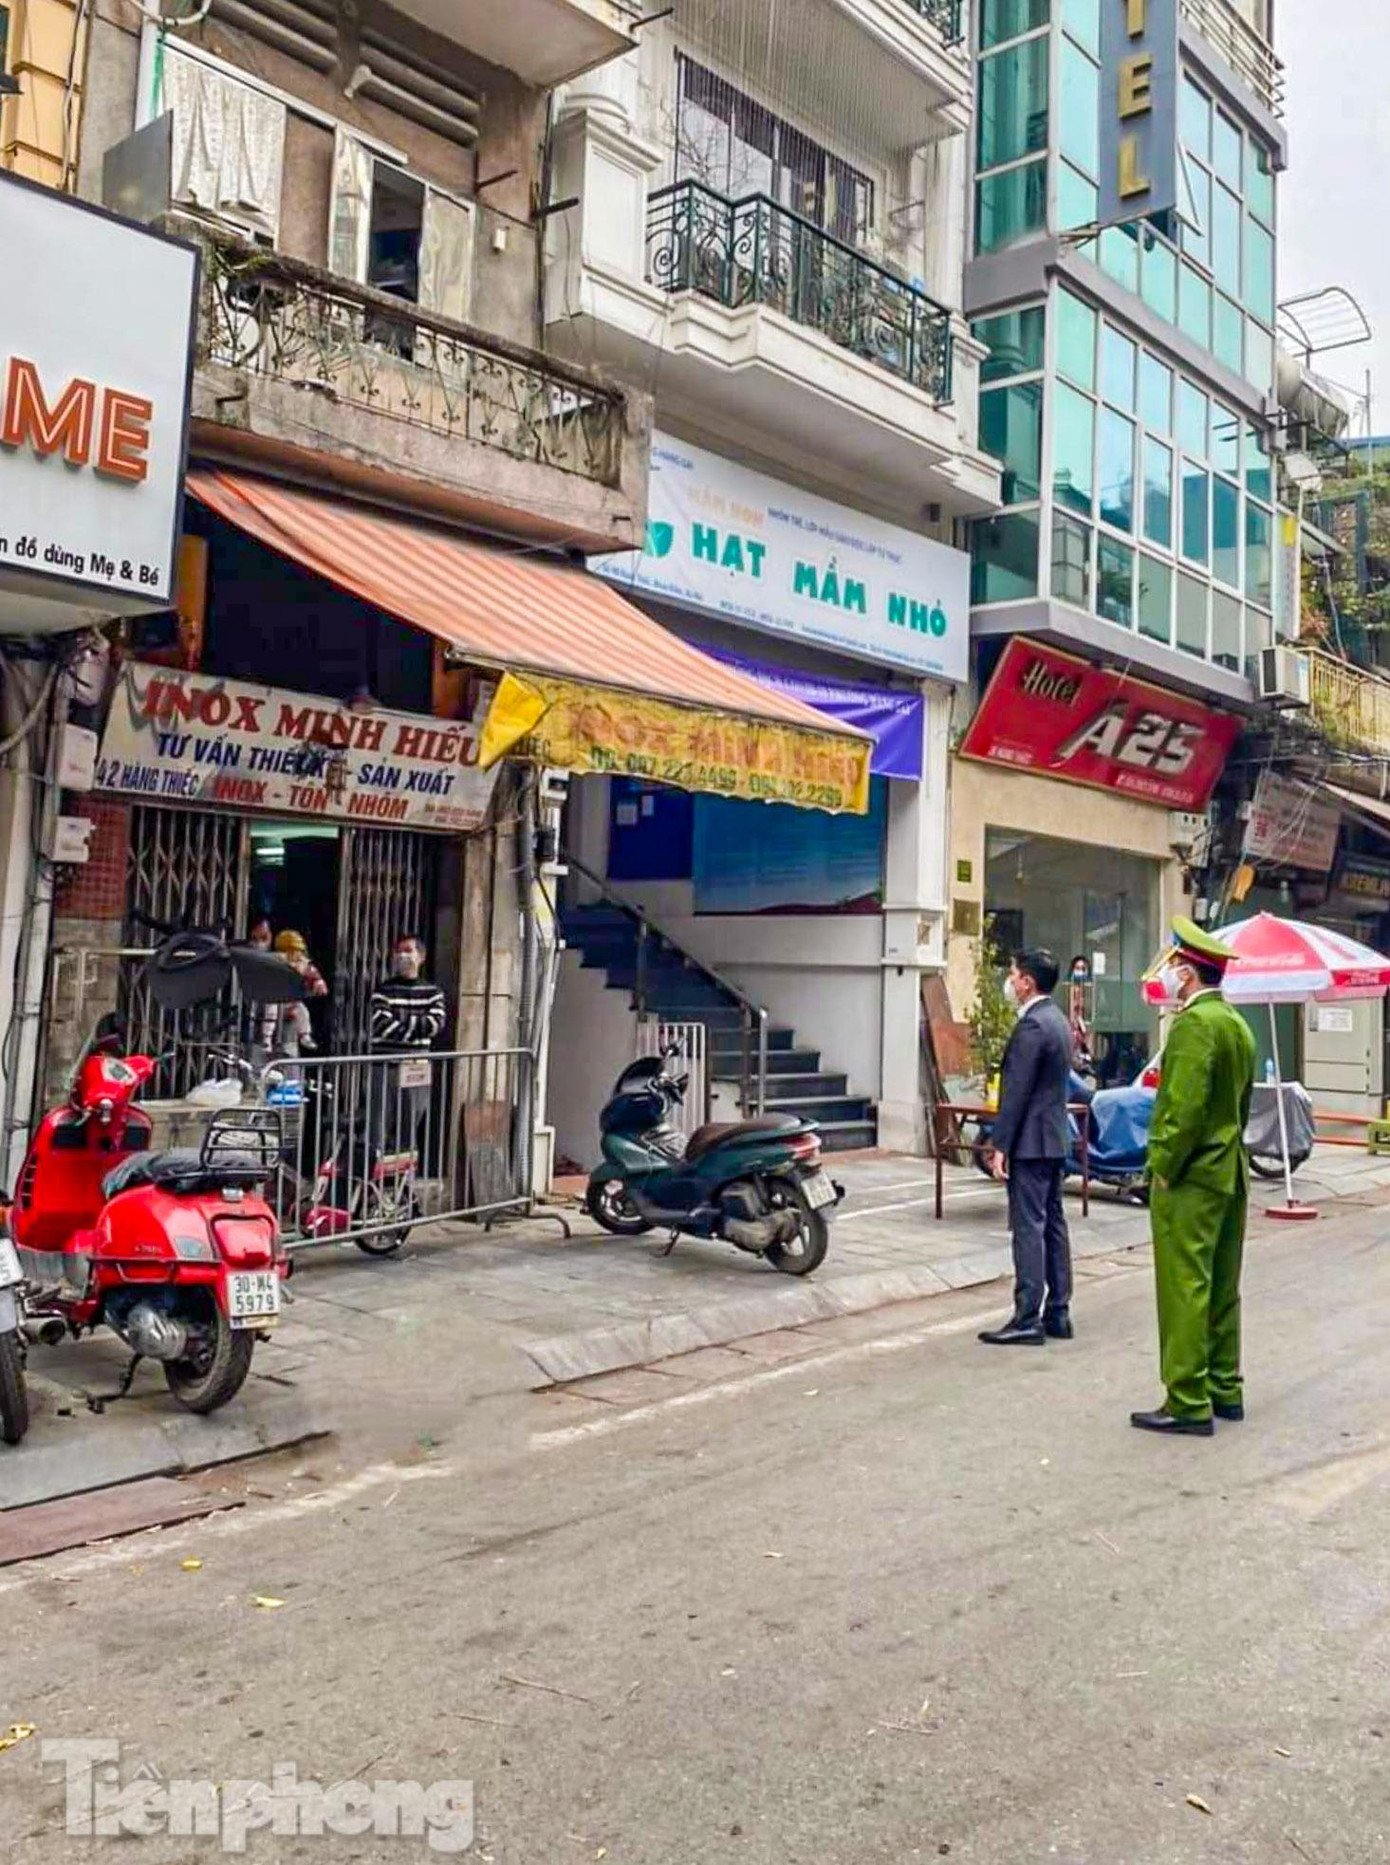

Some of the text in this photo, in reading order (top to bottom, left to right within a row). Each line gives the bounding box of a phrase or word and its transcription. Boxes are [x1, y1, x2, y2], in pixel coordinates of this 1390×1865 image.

[2, 355, 153, 481] ME
[44, 543, 85, 574] dùng
[91, 553, 116, 581] Mẹ
[120, 561, 134, 579] &
[139, 565, 159, 586] Bé
[692, 521, 767, 579] HẠT
[1023, 661, 1084, 708] Hotel
[272, 704, 388, 752] MINH
[1053, 698, 1207, 774] A25
[158, 733, 193, 760] TƯ
[194, 733, 242, 767] VẤN
[357, 757, 402, 789] SẢN
[404, 767, 456, 796] XUẤT
[215, 773, 268, 804] INOX
[236, 1294, 275, 1312] 5979
